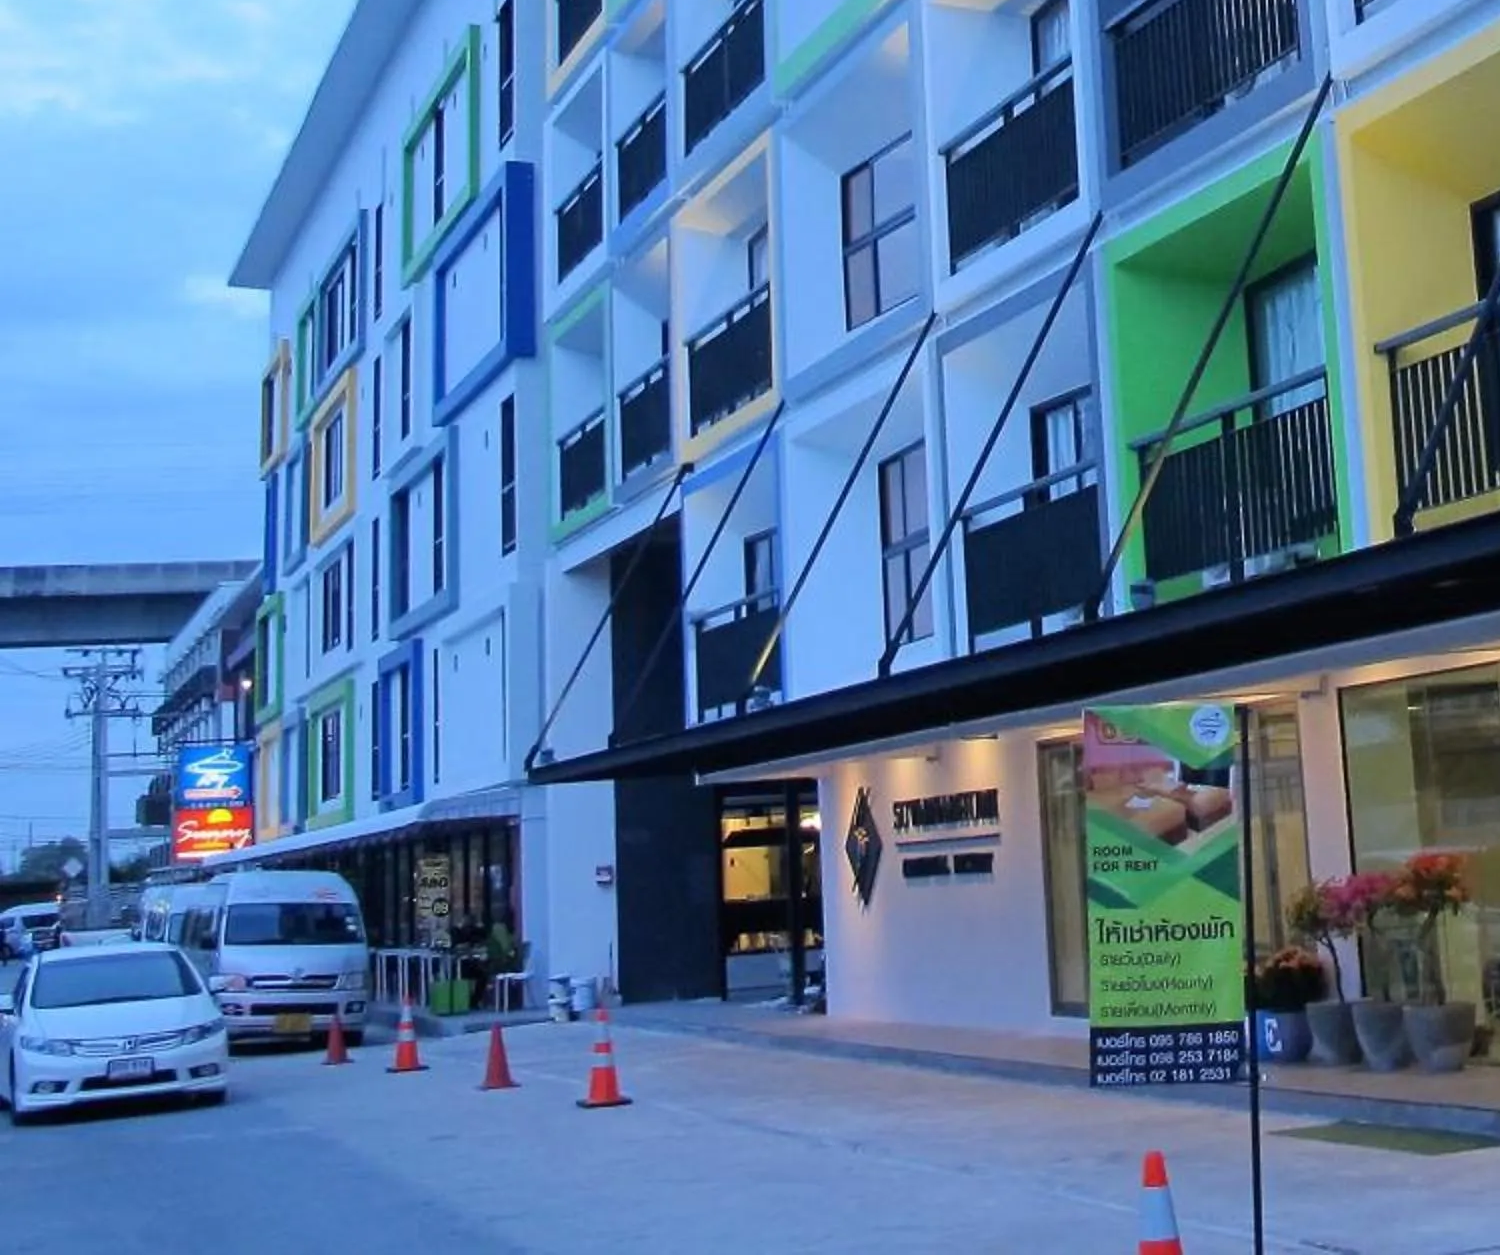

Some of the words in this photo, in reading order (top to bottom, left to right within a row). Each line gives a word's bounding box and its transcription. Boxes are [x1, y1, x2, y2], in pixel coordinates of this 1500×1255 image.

[1093, 846, 1133, 857] ROOM
[1093, 861, 1120, 873] FOR
[1125, 860, 1158, 872] RENT
[1208, 1030, 1239, 1044] 1850
[1179, 1050, 1203, 1064] 253
[1172, 1069, 1195, 1082] 181
